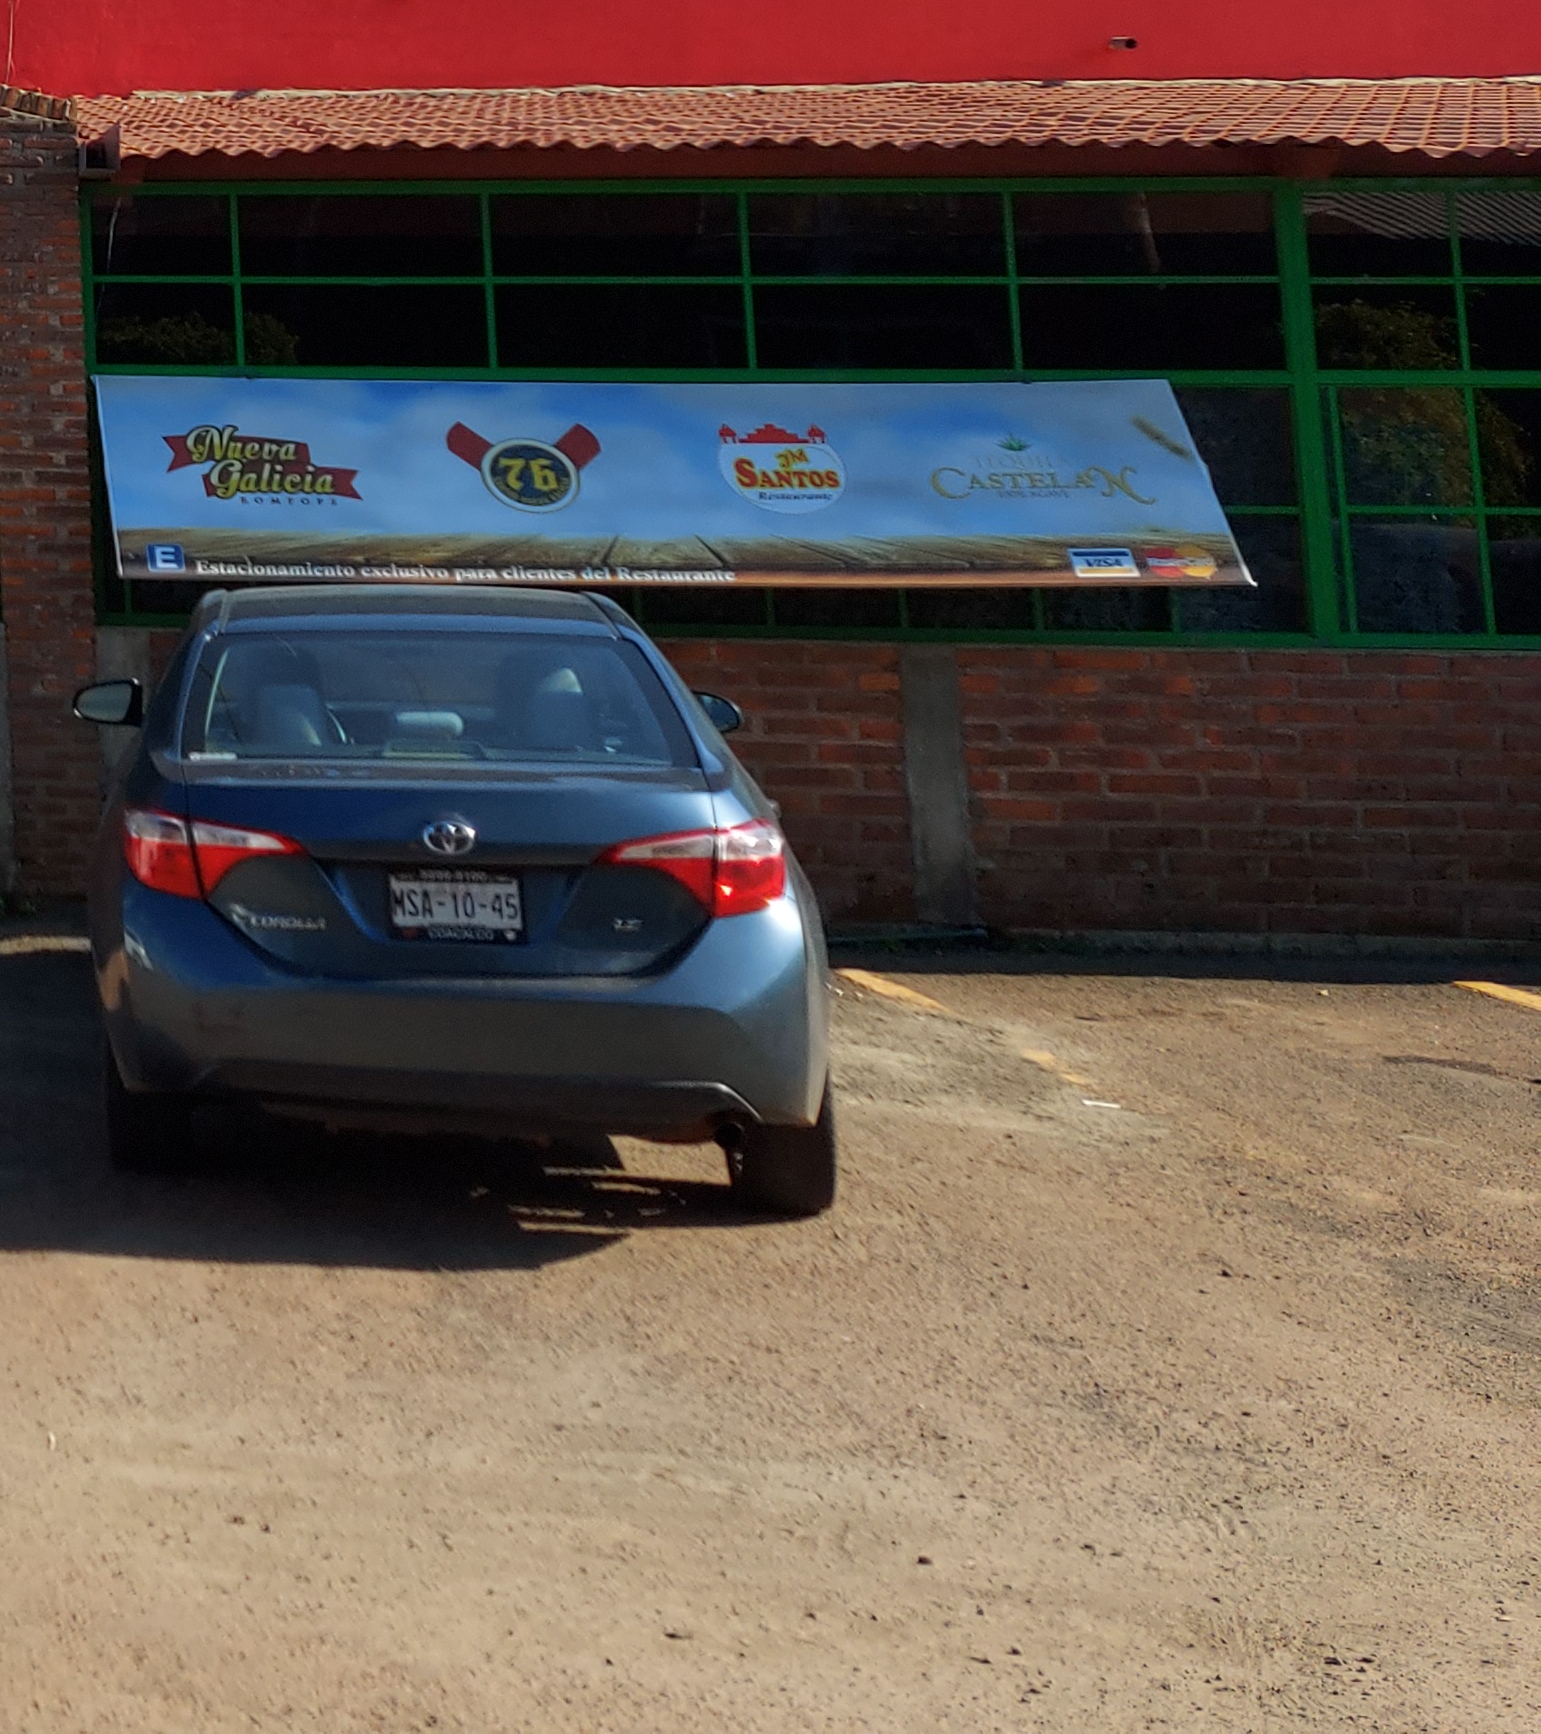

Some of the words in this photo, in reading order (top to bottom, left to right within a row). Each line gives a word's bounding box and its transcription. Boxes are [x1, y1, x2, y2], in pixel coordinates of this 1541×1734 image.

[186, 424, 297, 463] Nueva
[208, 459, 335, 500] Galicia
[499, 457, 558, 491] 76
[733, 457, 840, 489] SANTOS
[155, 546, 179, 568] E
[195, 560, 355, 578] Estacionamiento
[359, 562, 449, 579] exclusivo
[456, 568, 498, 583] para
[501, 565, 577, 581] clientes
[581, 566, 612, 581] del
[616, 567, 737, 582] Restaurante
[391, 888, 519, 920] MSA-10-45
